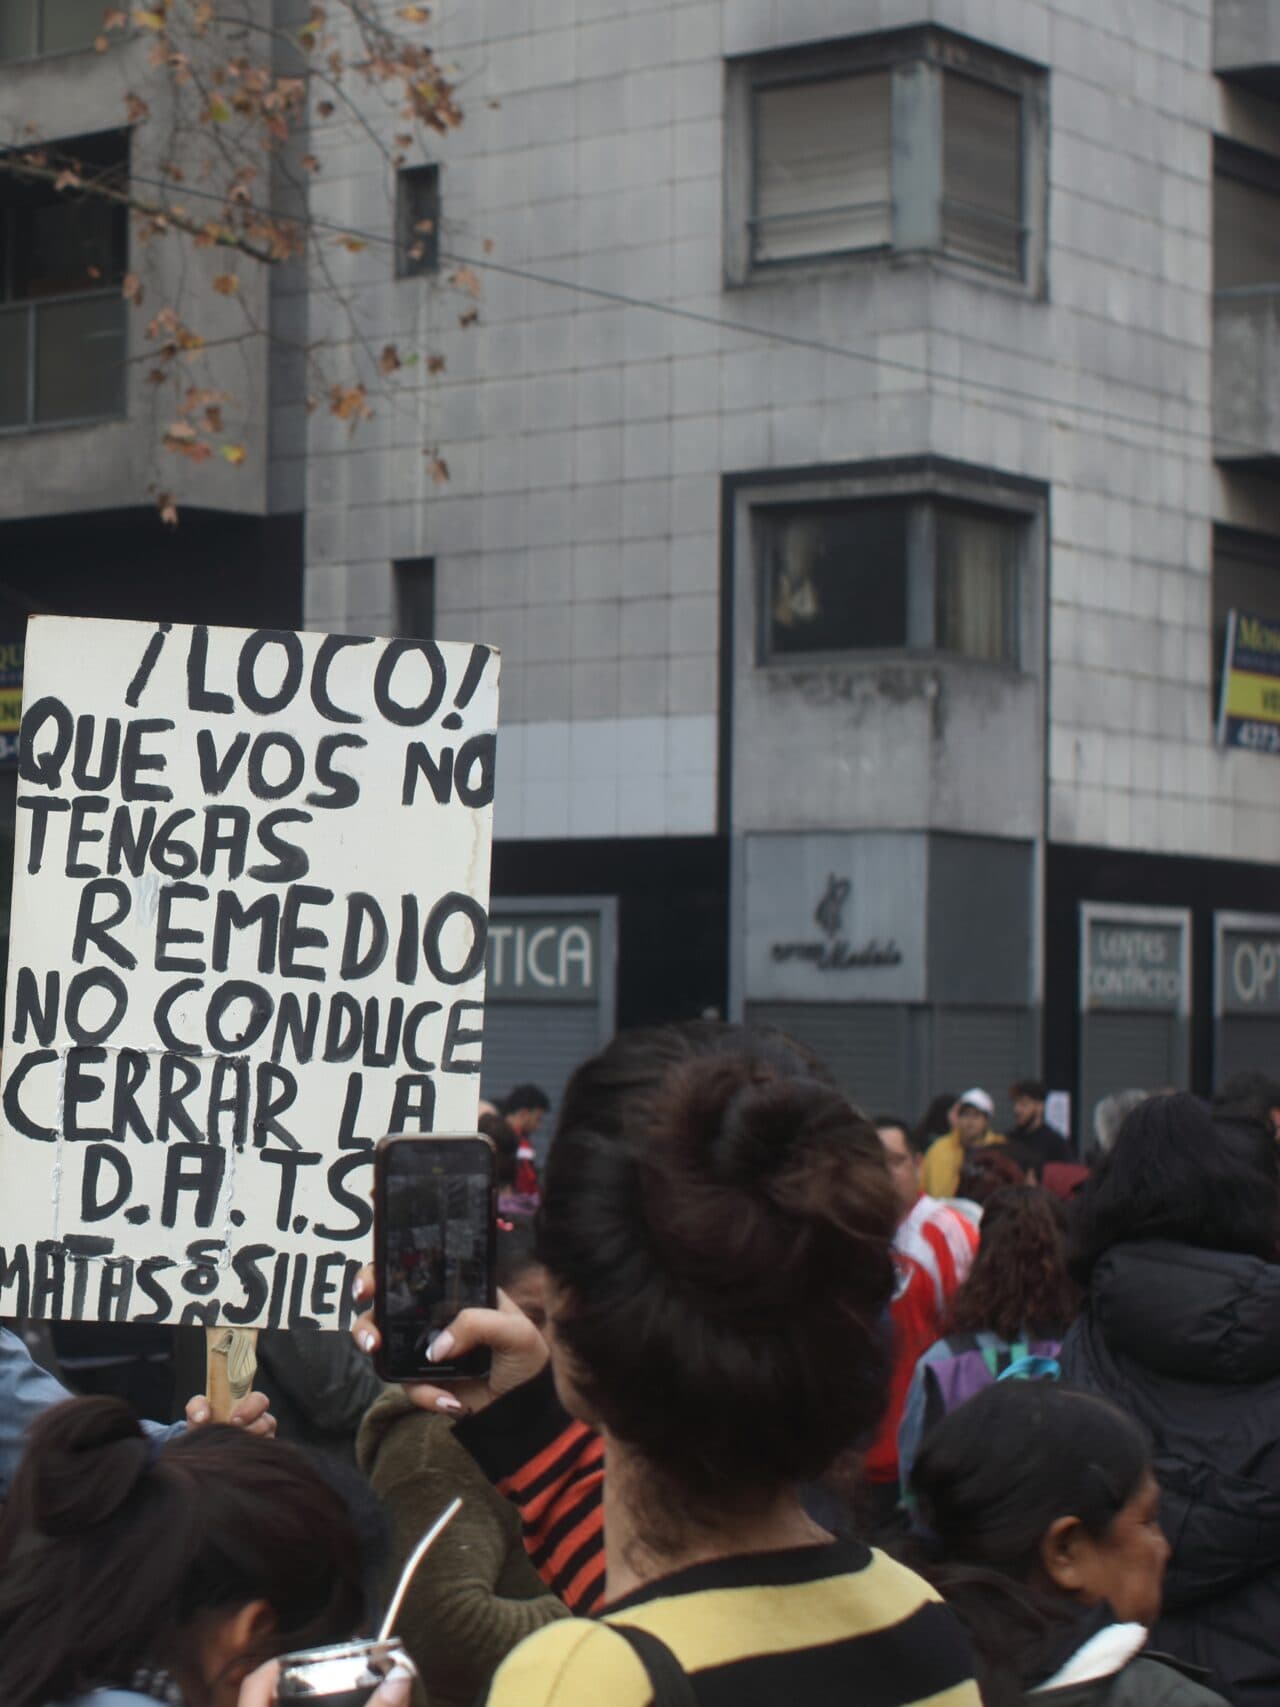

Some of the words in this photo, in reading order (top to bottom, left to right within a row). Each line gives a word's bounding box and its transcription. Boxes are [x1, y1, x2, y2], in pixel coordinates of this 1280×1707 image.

[19, 697, 175, 801] QUE
[196, 729, 368, 808] VOS
[402, 733, 496, 808] NO
[17, 796, 313, 883] TENGAS
[72, 878, 488, 986] REMEDIO
[487, 926, 592, 987] TICA
[12, 966, 128, 1048] NO
[154, 978, 484, 1074] CONDUCE
[3, 1046, 302, 1151] CERRAR
[338, 1072, 436, 1150] LA
